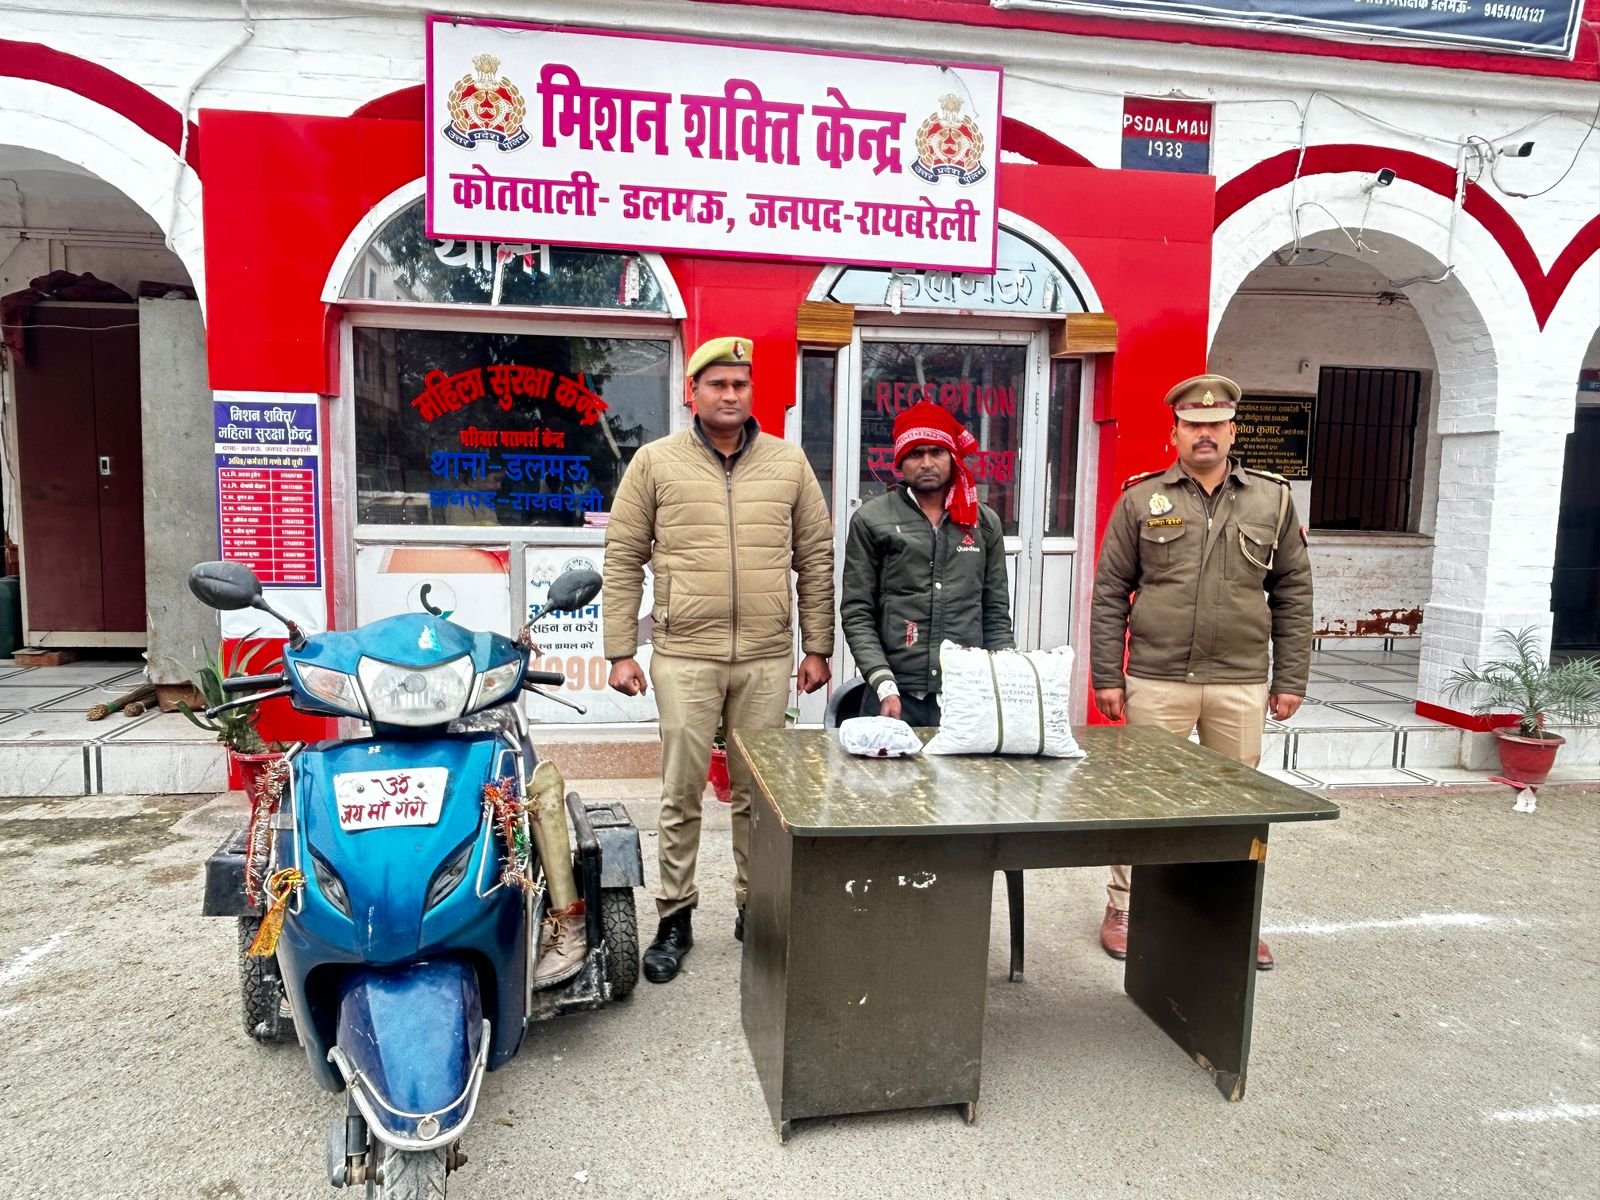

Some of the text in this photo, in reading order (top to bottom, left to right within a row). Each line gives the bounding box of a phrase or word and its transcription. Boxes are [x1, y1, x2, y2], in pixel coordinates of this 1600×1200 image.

[1484, 3, 1546, 23] 9454404127
[537, 63, 906, 176] मिशन शक्ति केन्द्र
[1148, 140, 1183, 158] 1938
[450, 164, 609, 217] कोतवाली-
[619, 184, 735, 233] डलमऊ,
[411, 368, 485, 422] महिला
[487, 364, 554, 411] सुरक्षा
[229, 405, 260, 422] मिशन
[218, 423, 312, 443] महिला सुरक्षा केन्द्र
[532, 623, 559, 634] सहन
[563, 624, 572, 633] न
[341, 804, 366, 824] जय
